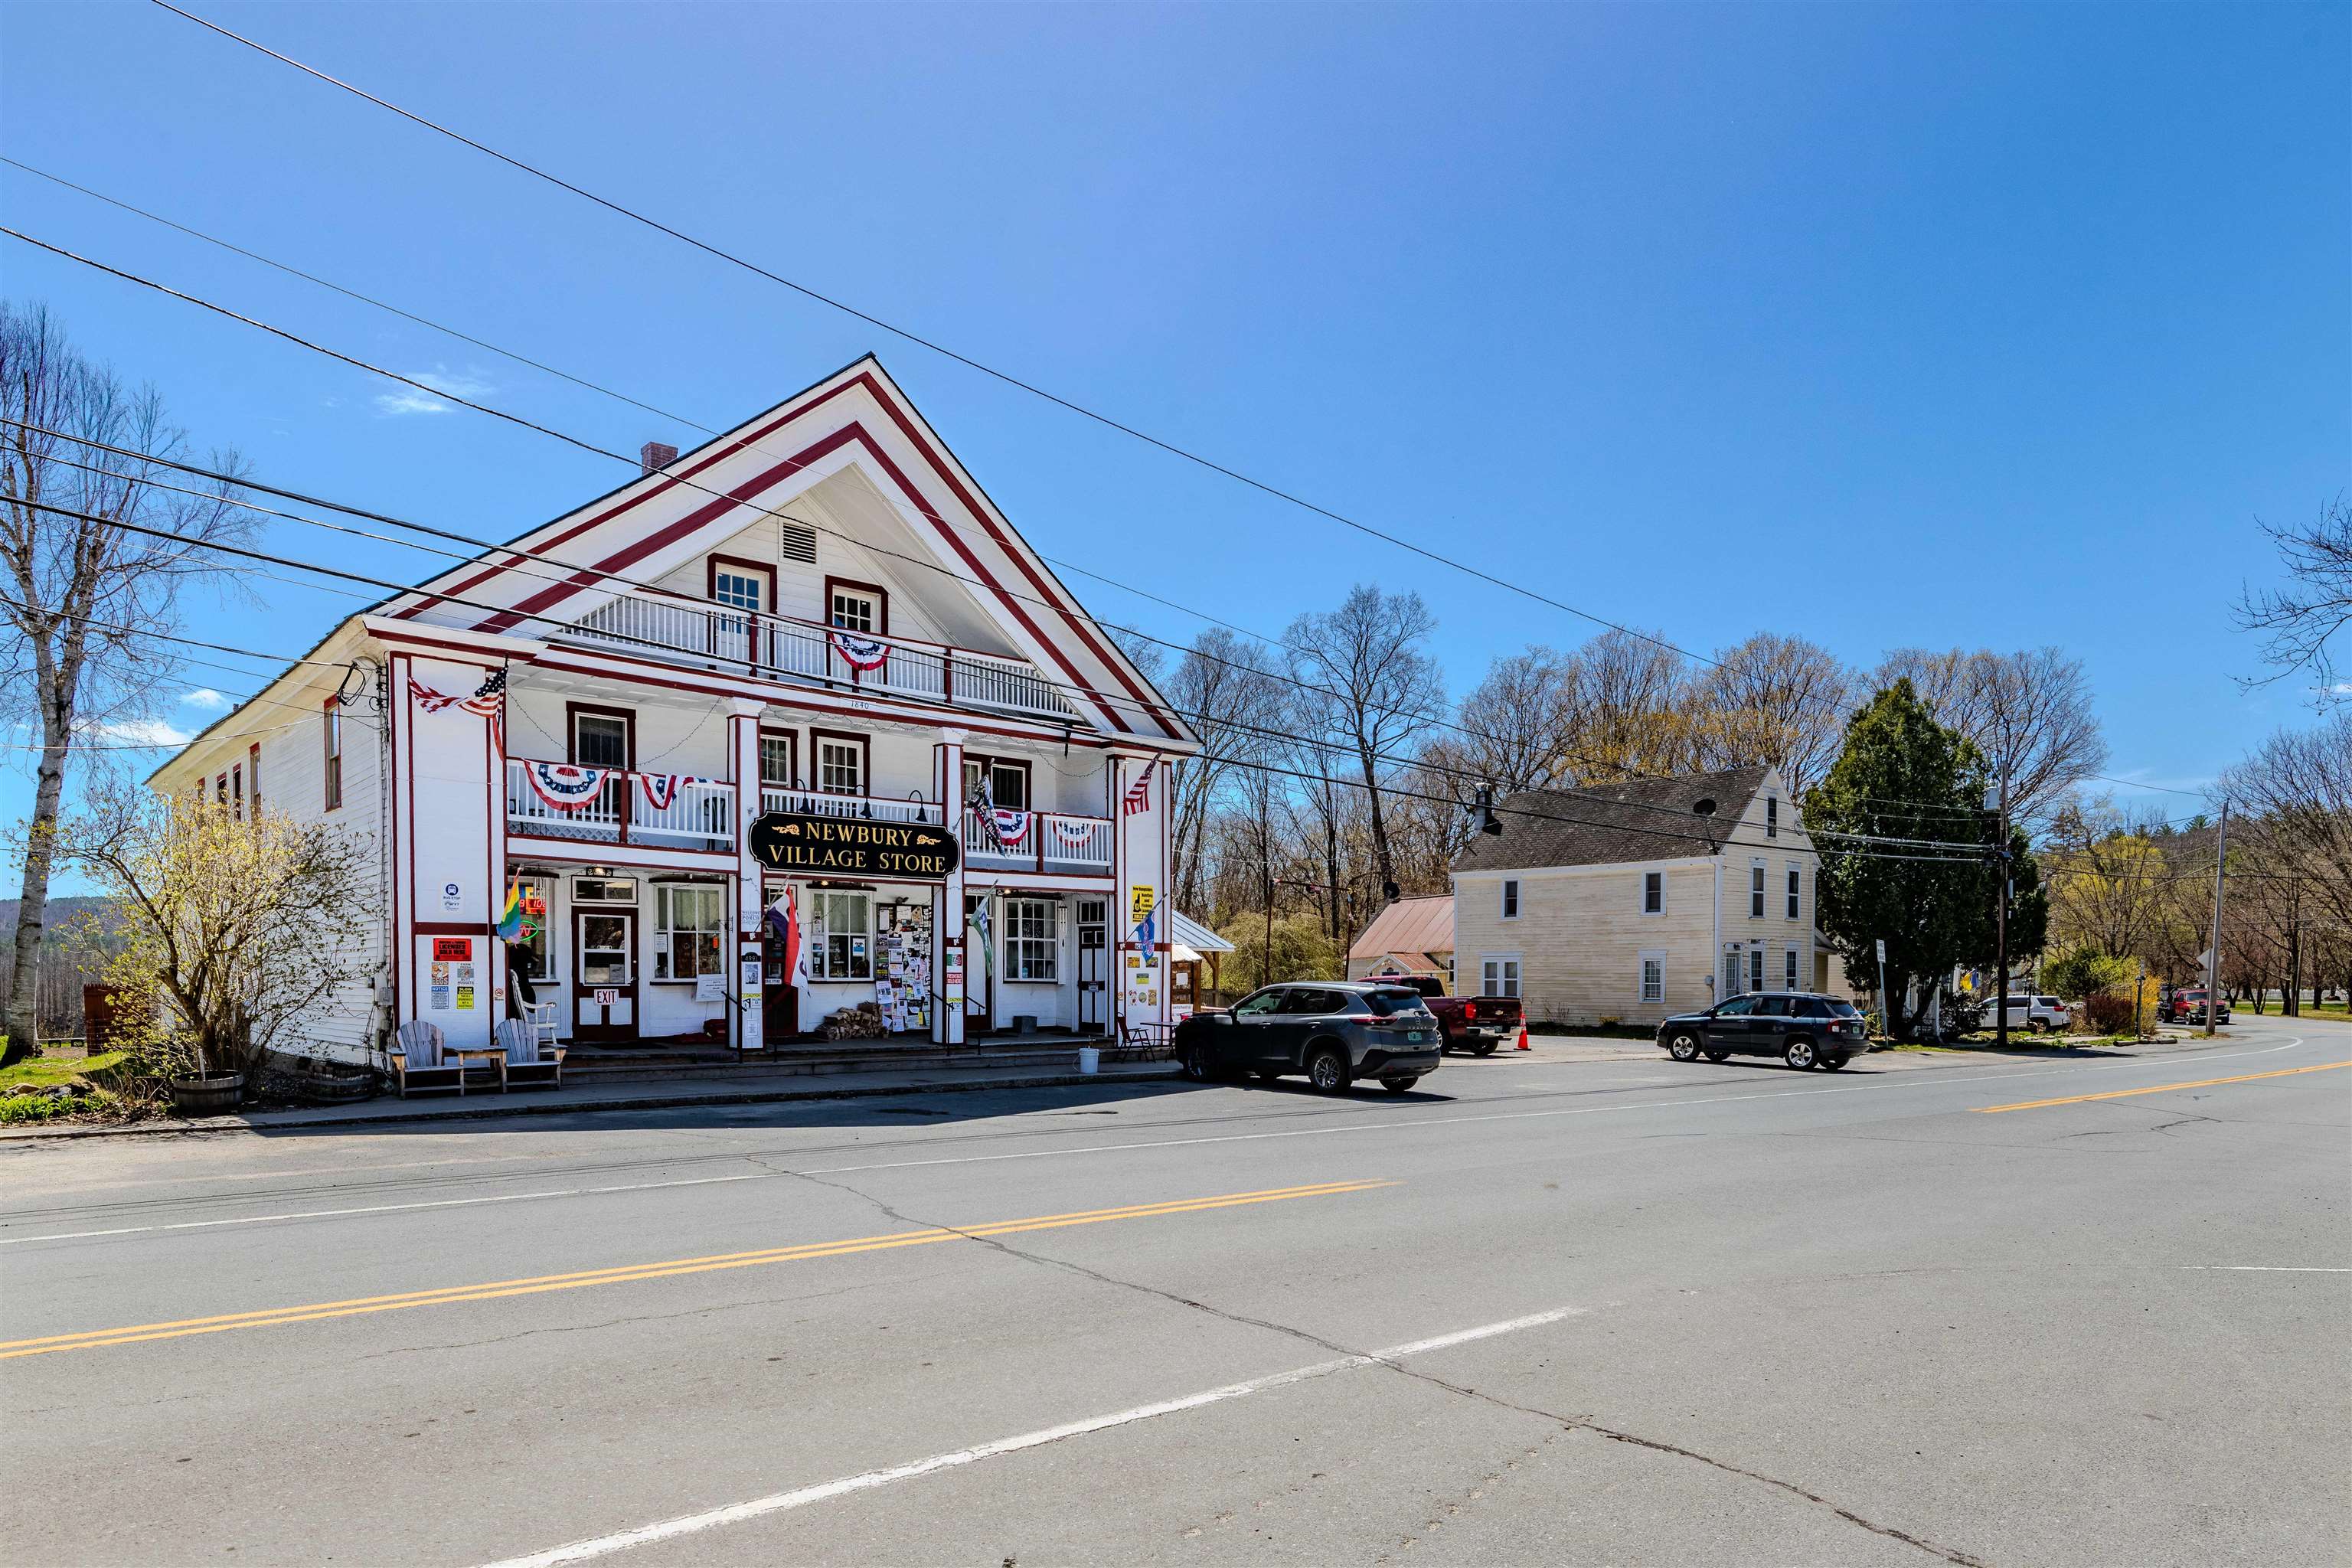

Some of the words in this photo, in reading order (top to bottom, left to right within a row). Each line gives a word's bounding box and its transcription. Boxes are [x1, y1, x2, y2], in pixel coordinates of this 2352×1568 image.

[851, 701, 869, 709] 1840
[805, 822, 913, 846] NEWBURY
[769, 844, 867, 867] VILLAGE
[880, 852, 946, 872] STORE
[597, 991, 616, 1003] EXIT
